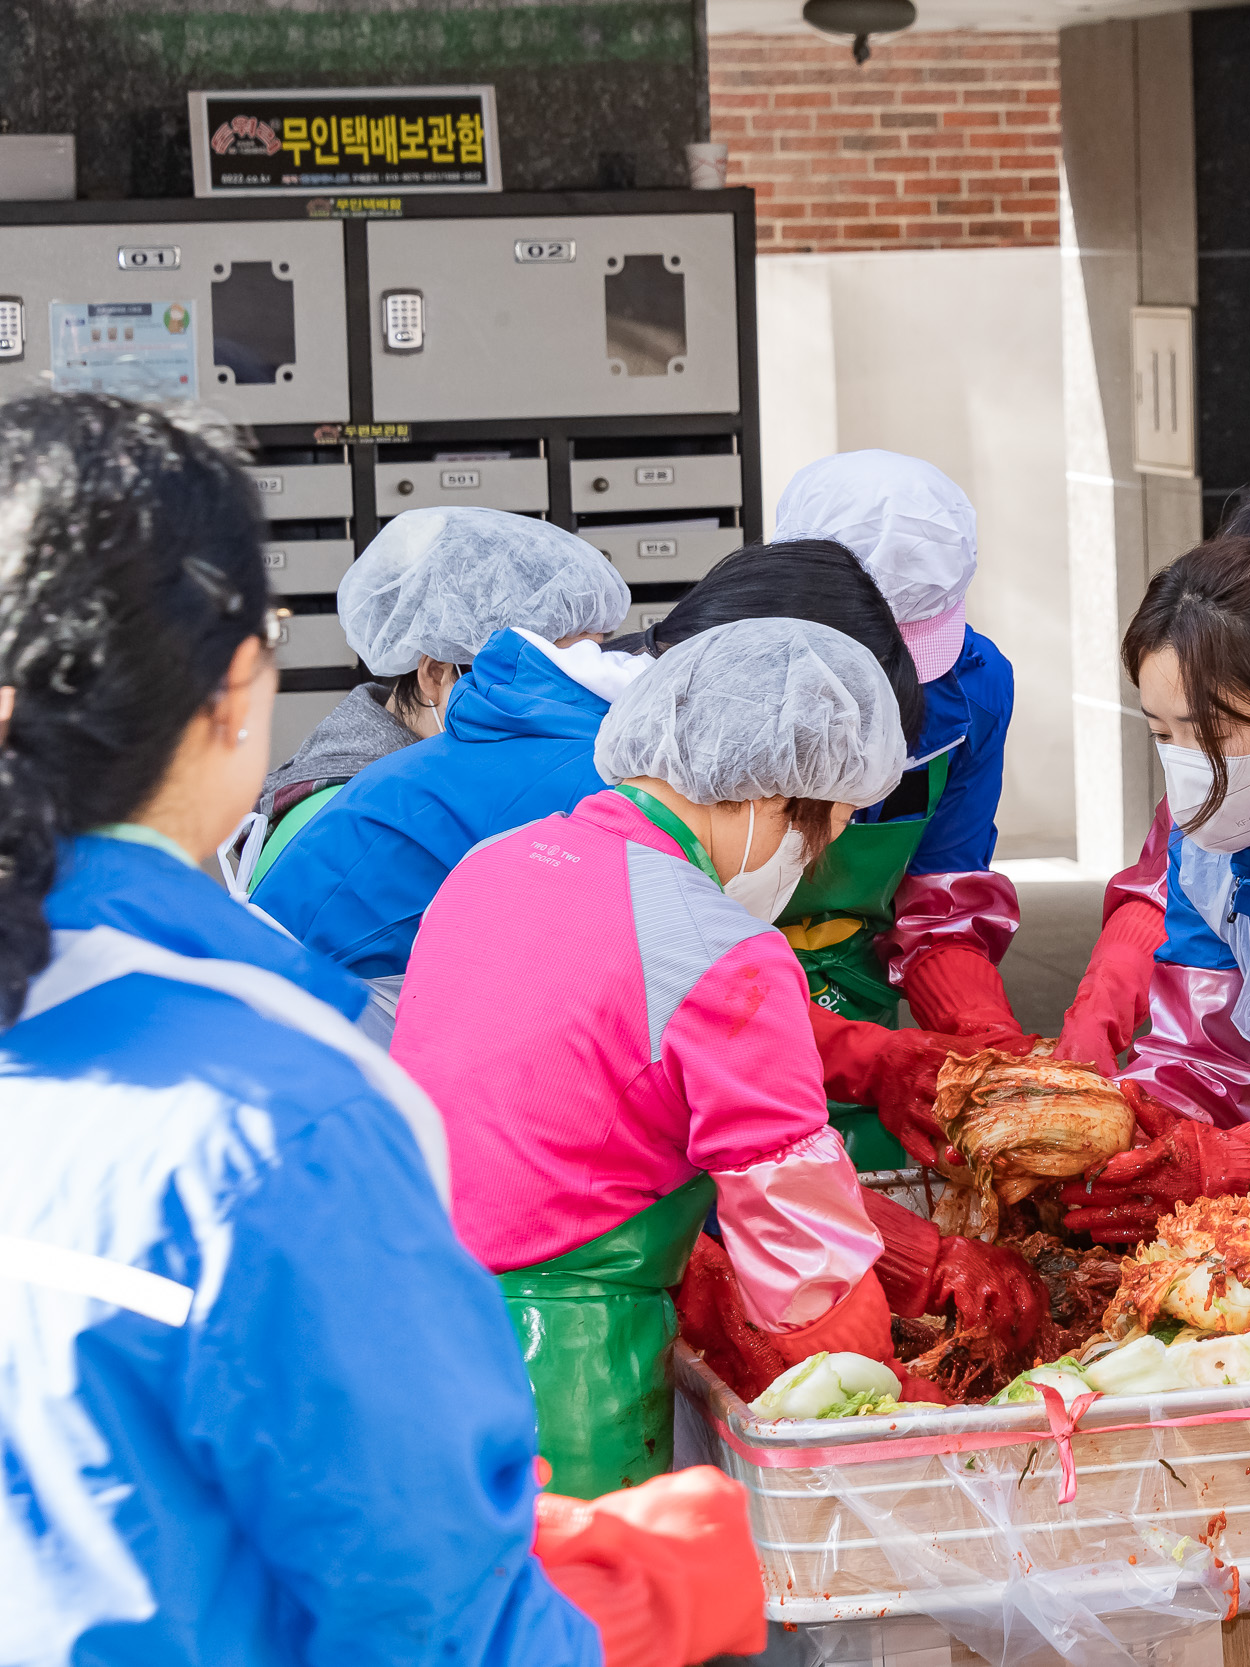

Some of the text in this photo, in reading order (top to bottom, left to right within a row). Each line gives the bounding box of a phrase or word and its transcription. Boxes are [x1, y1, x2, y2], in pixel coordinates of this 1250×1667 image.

[282, 113, 484, 167] 무인택배보관함
[528, 243, 562, 258] 02
[131, 251, 164, 266] 01
[529, 852, 560, 867] SPORTS
[530, 841, 580, 863] TWO TWO
